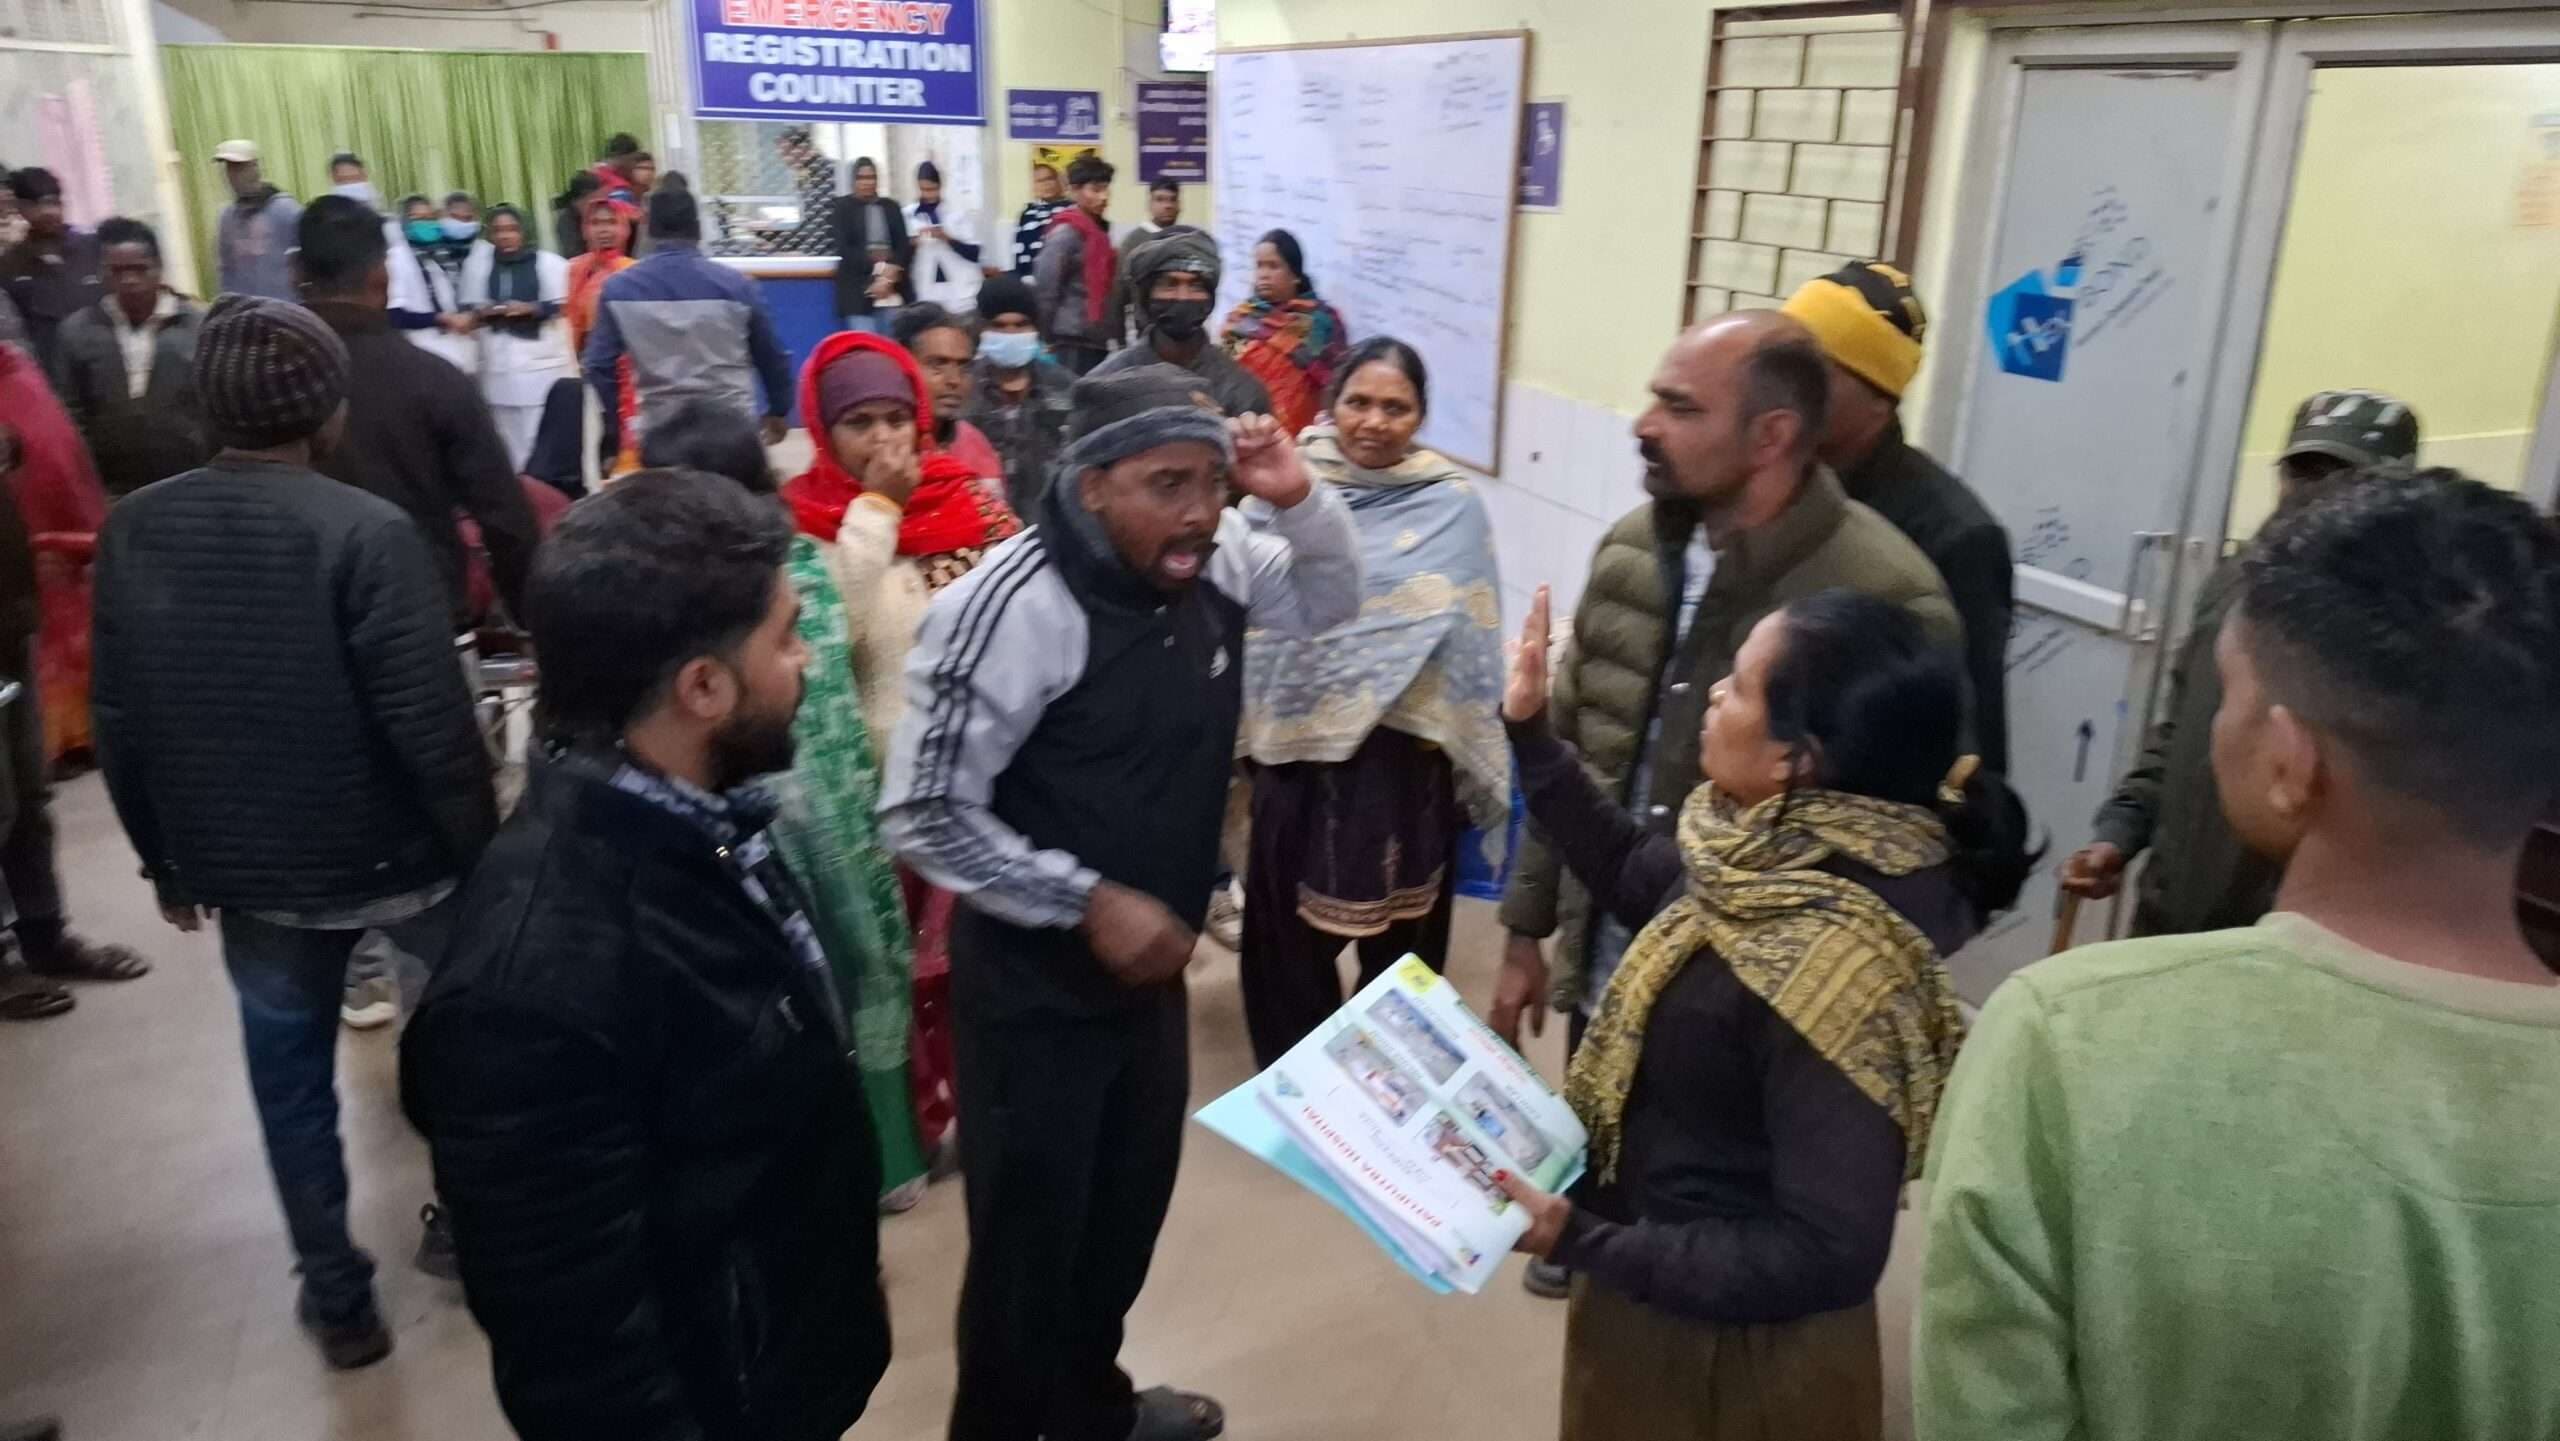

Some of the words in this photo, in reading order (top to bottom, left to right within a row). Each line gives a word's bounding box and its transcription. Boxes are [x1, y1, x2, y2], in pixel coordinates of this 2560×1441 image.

[721, 0, 951, 35] EMERGENCY
[703, 32, 972, 72] REGISTRATION
[749, 72, 926, 106] COUNTER
